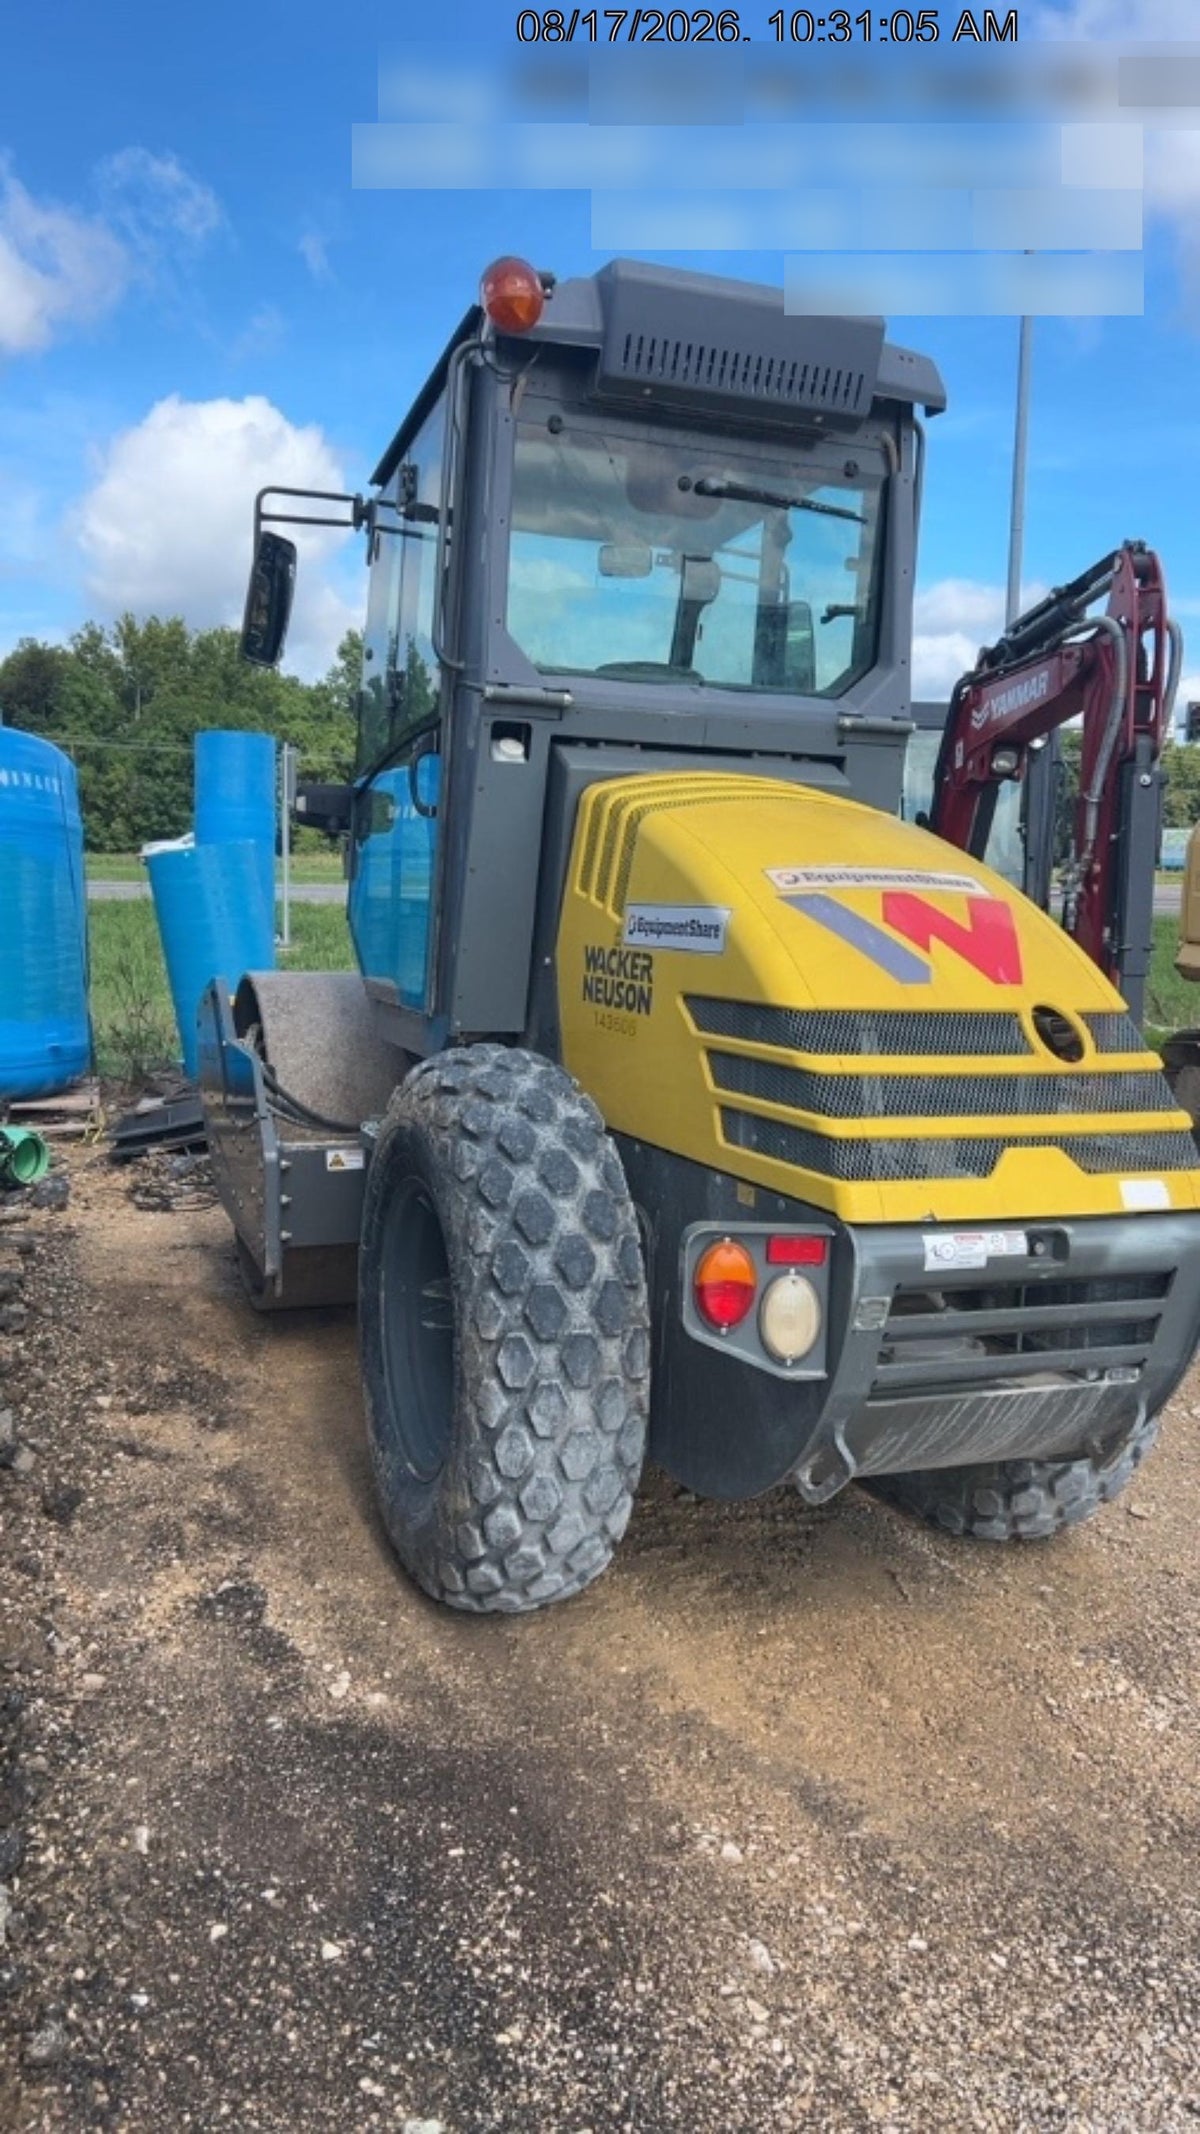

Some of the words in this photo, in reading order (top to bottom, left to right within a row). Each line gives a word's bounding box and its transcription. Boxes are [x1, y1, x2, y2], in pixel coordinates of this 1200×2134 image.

[991, 671, 1049, 719] YANMAR
[801, 872, 975, 889] EquipmentShare
[637, 916, 721, 940] EquipmentShare
[584, 945, 654, 984] WACKER
[583, 974, 653, 1016] NEUSON
